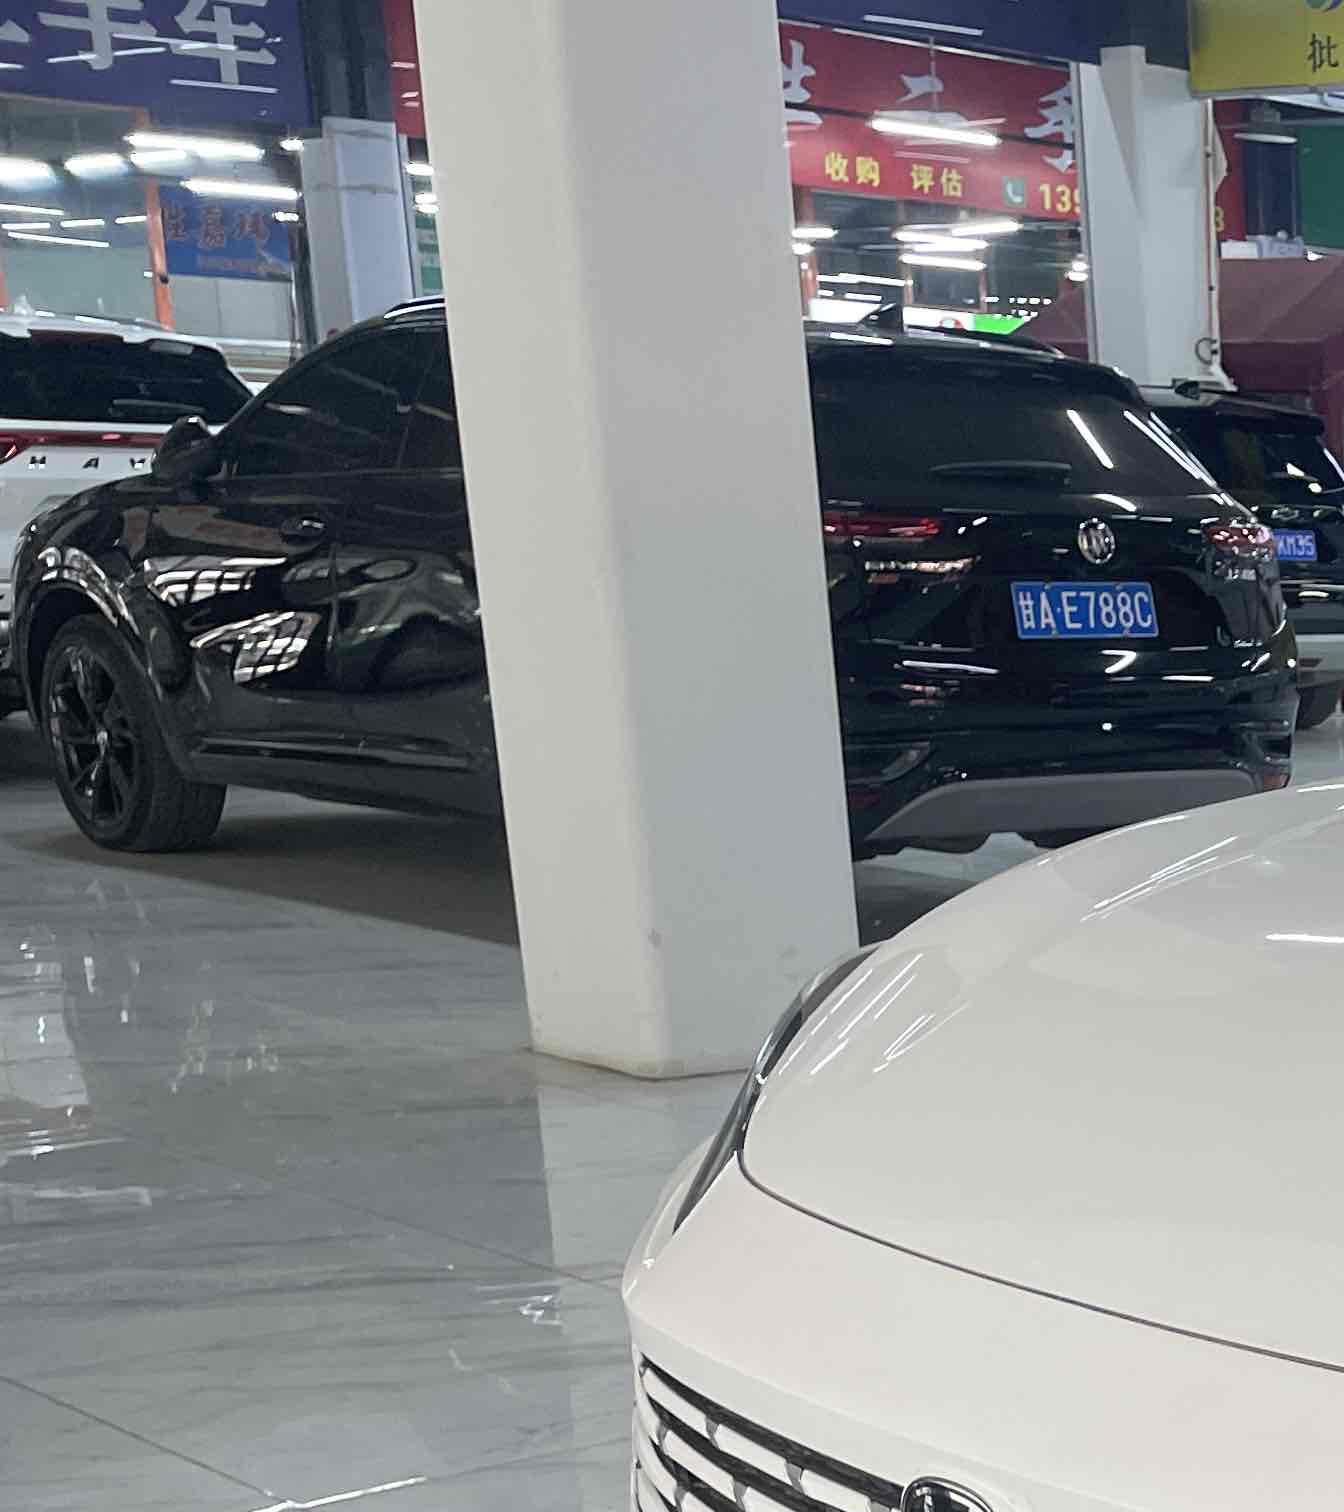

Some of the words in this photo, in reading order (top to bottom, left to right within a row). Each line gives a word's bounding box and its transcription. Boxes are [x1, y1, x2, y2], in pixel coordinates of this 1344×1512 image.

[0, 0, 277, 84] 手车
[824, 151, 881, 188] 收购
[911, 164, 964, 198] 评估
